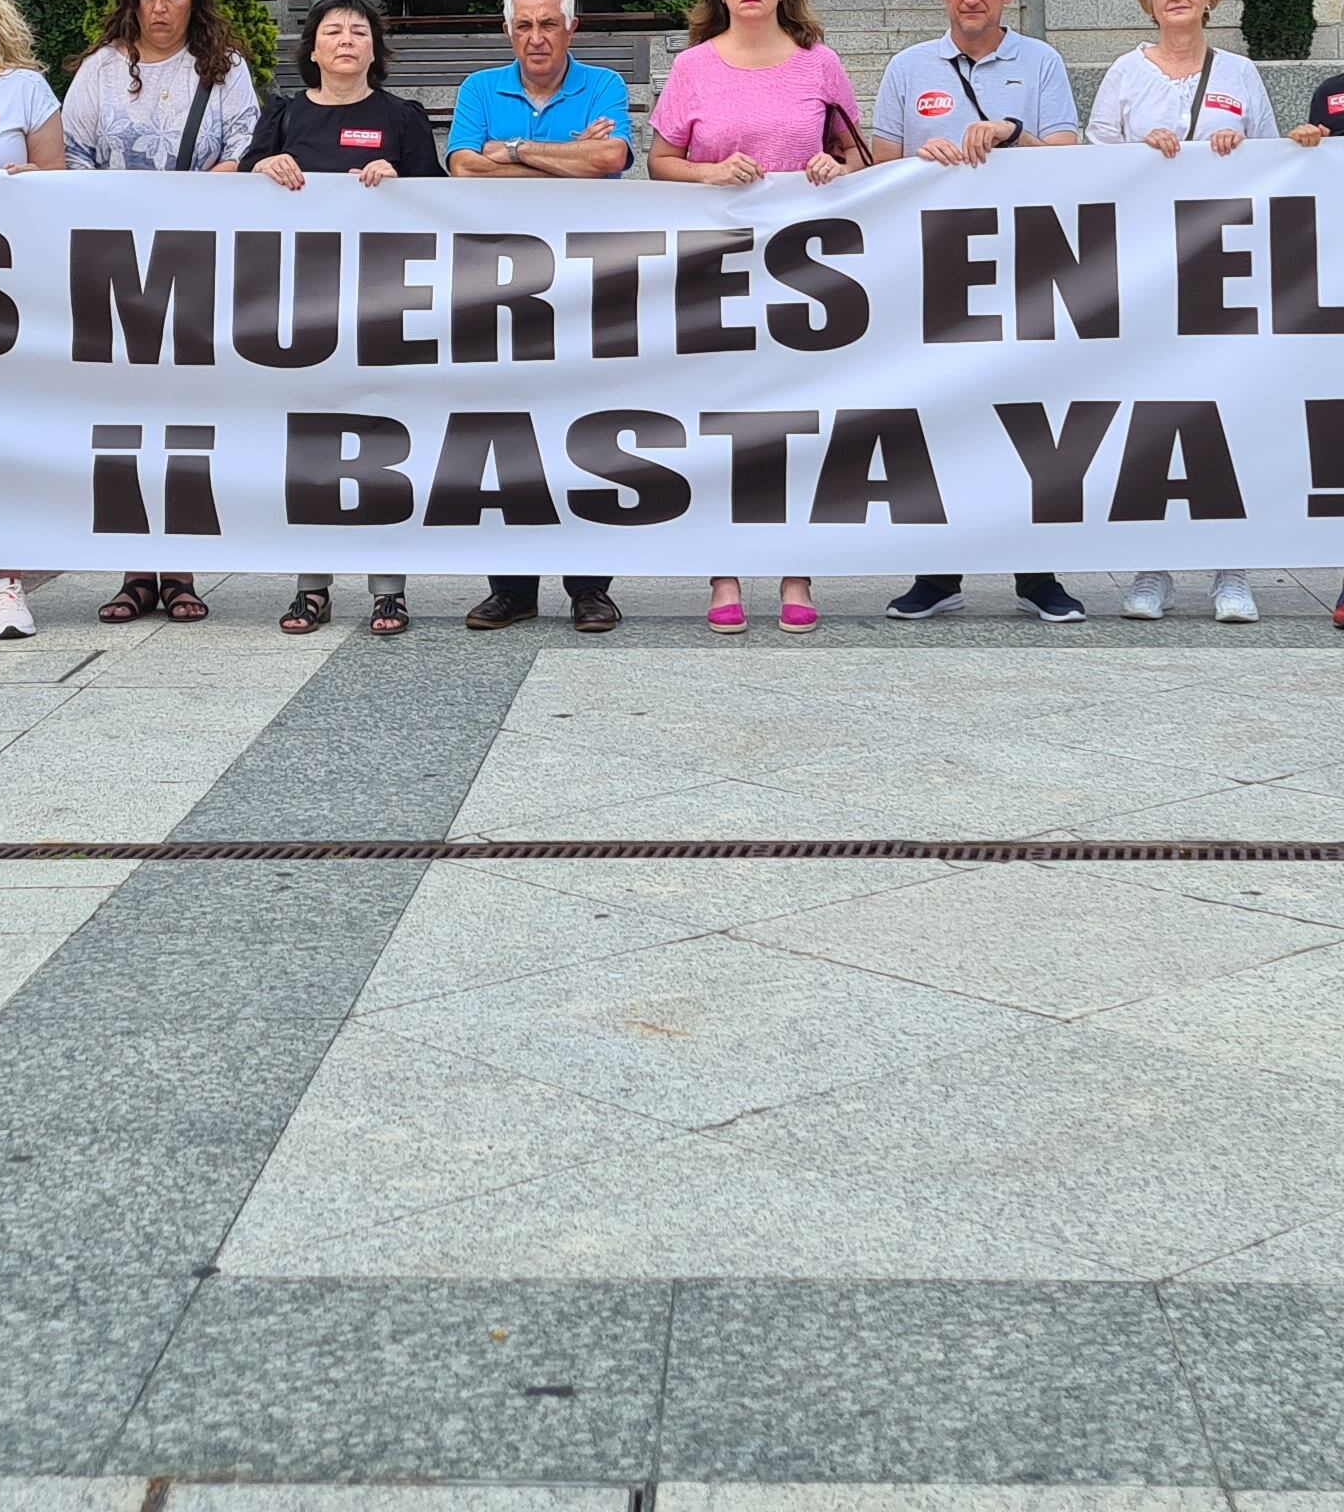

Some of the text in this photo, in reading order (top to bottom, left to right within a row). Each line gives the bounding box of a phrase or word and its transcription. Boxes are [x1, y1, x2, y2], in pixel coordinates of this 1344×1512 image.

[69, 217, 871, 370] MUERTES
[920, 202, 1121, 344] EN
[91, 424, 223, 536] ¡¡
[284, 407, 949, 527] BASTA
[992, 400, 1249, 524] YA
